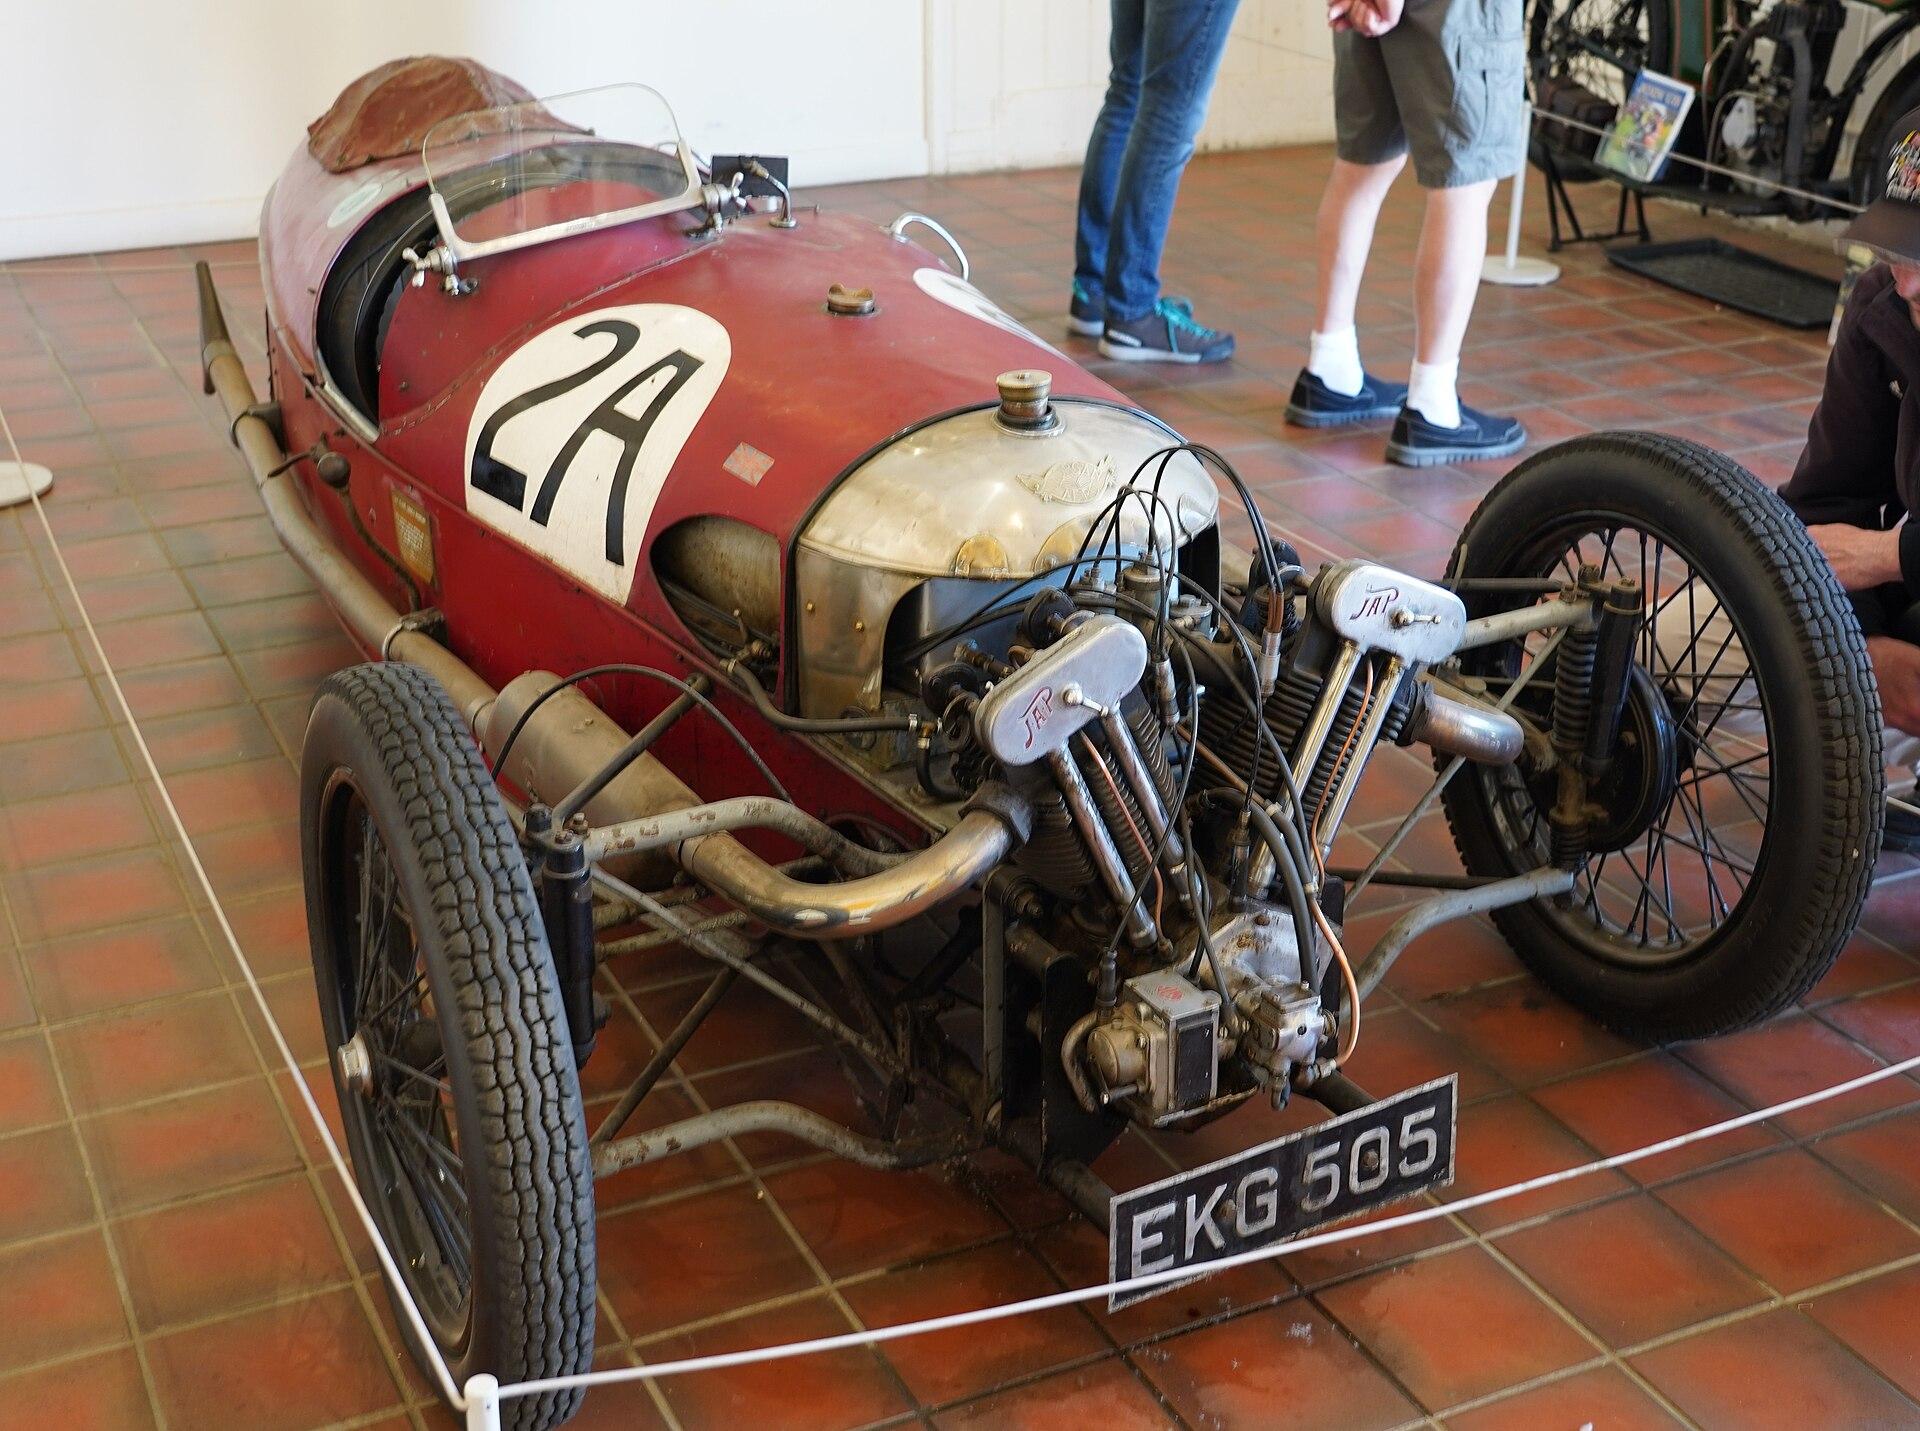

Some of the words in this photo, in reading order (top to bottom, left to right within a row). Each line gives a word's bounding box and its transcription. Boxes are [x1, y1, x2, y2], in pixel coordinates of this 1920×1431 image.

[470, 320, 705, 566] 2A
[1349, 583, 1400, 620] JAP
[1018, 686, 1053, 749] JAP
[1131, 1166, 1279, 1279] EKG
[1301, 1106, 1437, 1213] 505
